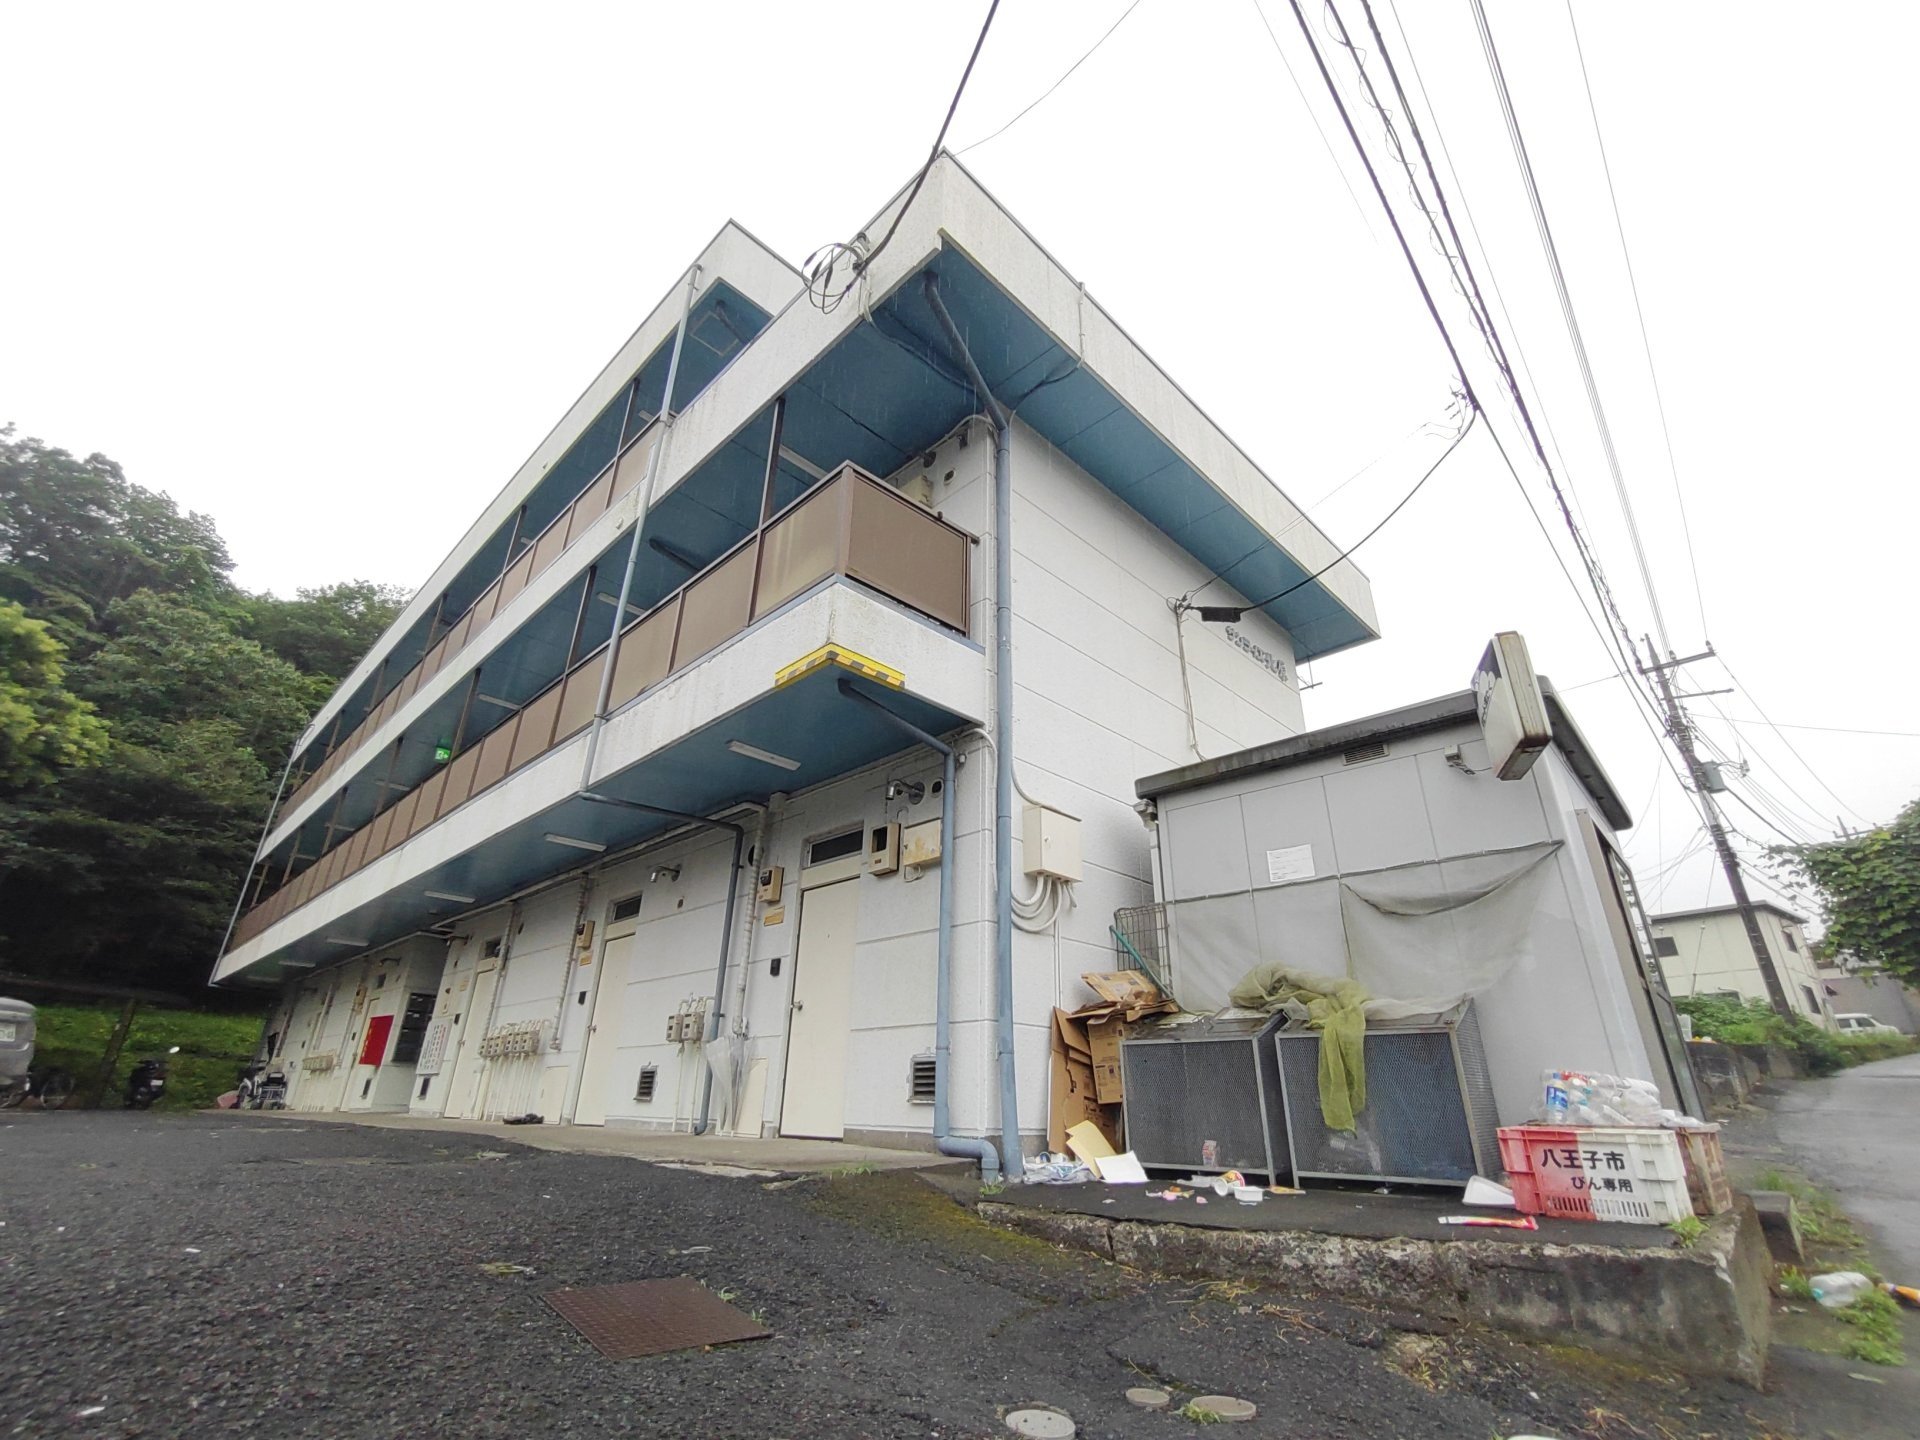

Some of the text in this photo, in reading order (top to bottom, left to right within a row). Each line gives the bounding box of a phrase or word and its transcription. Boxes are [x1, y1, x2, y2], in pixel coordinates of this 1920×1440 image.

[1541, 1148, 1626, 1172] 八王子市
[1571, 1176, 1634, 1193] びん専用
